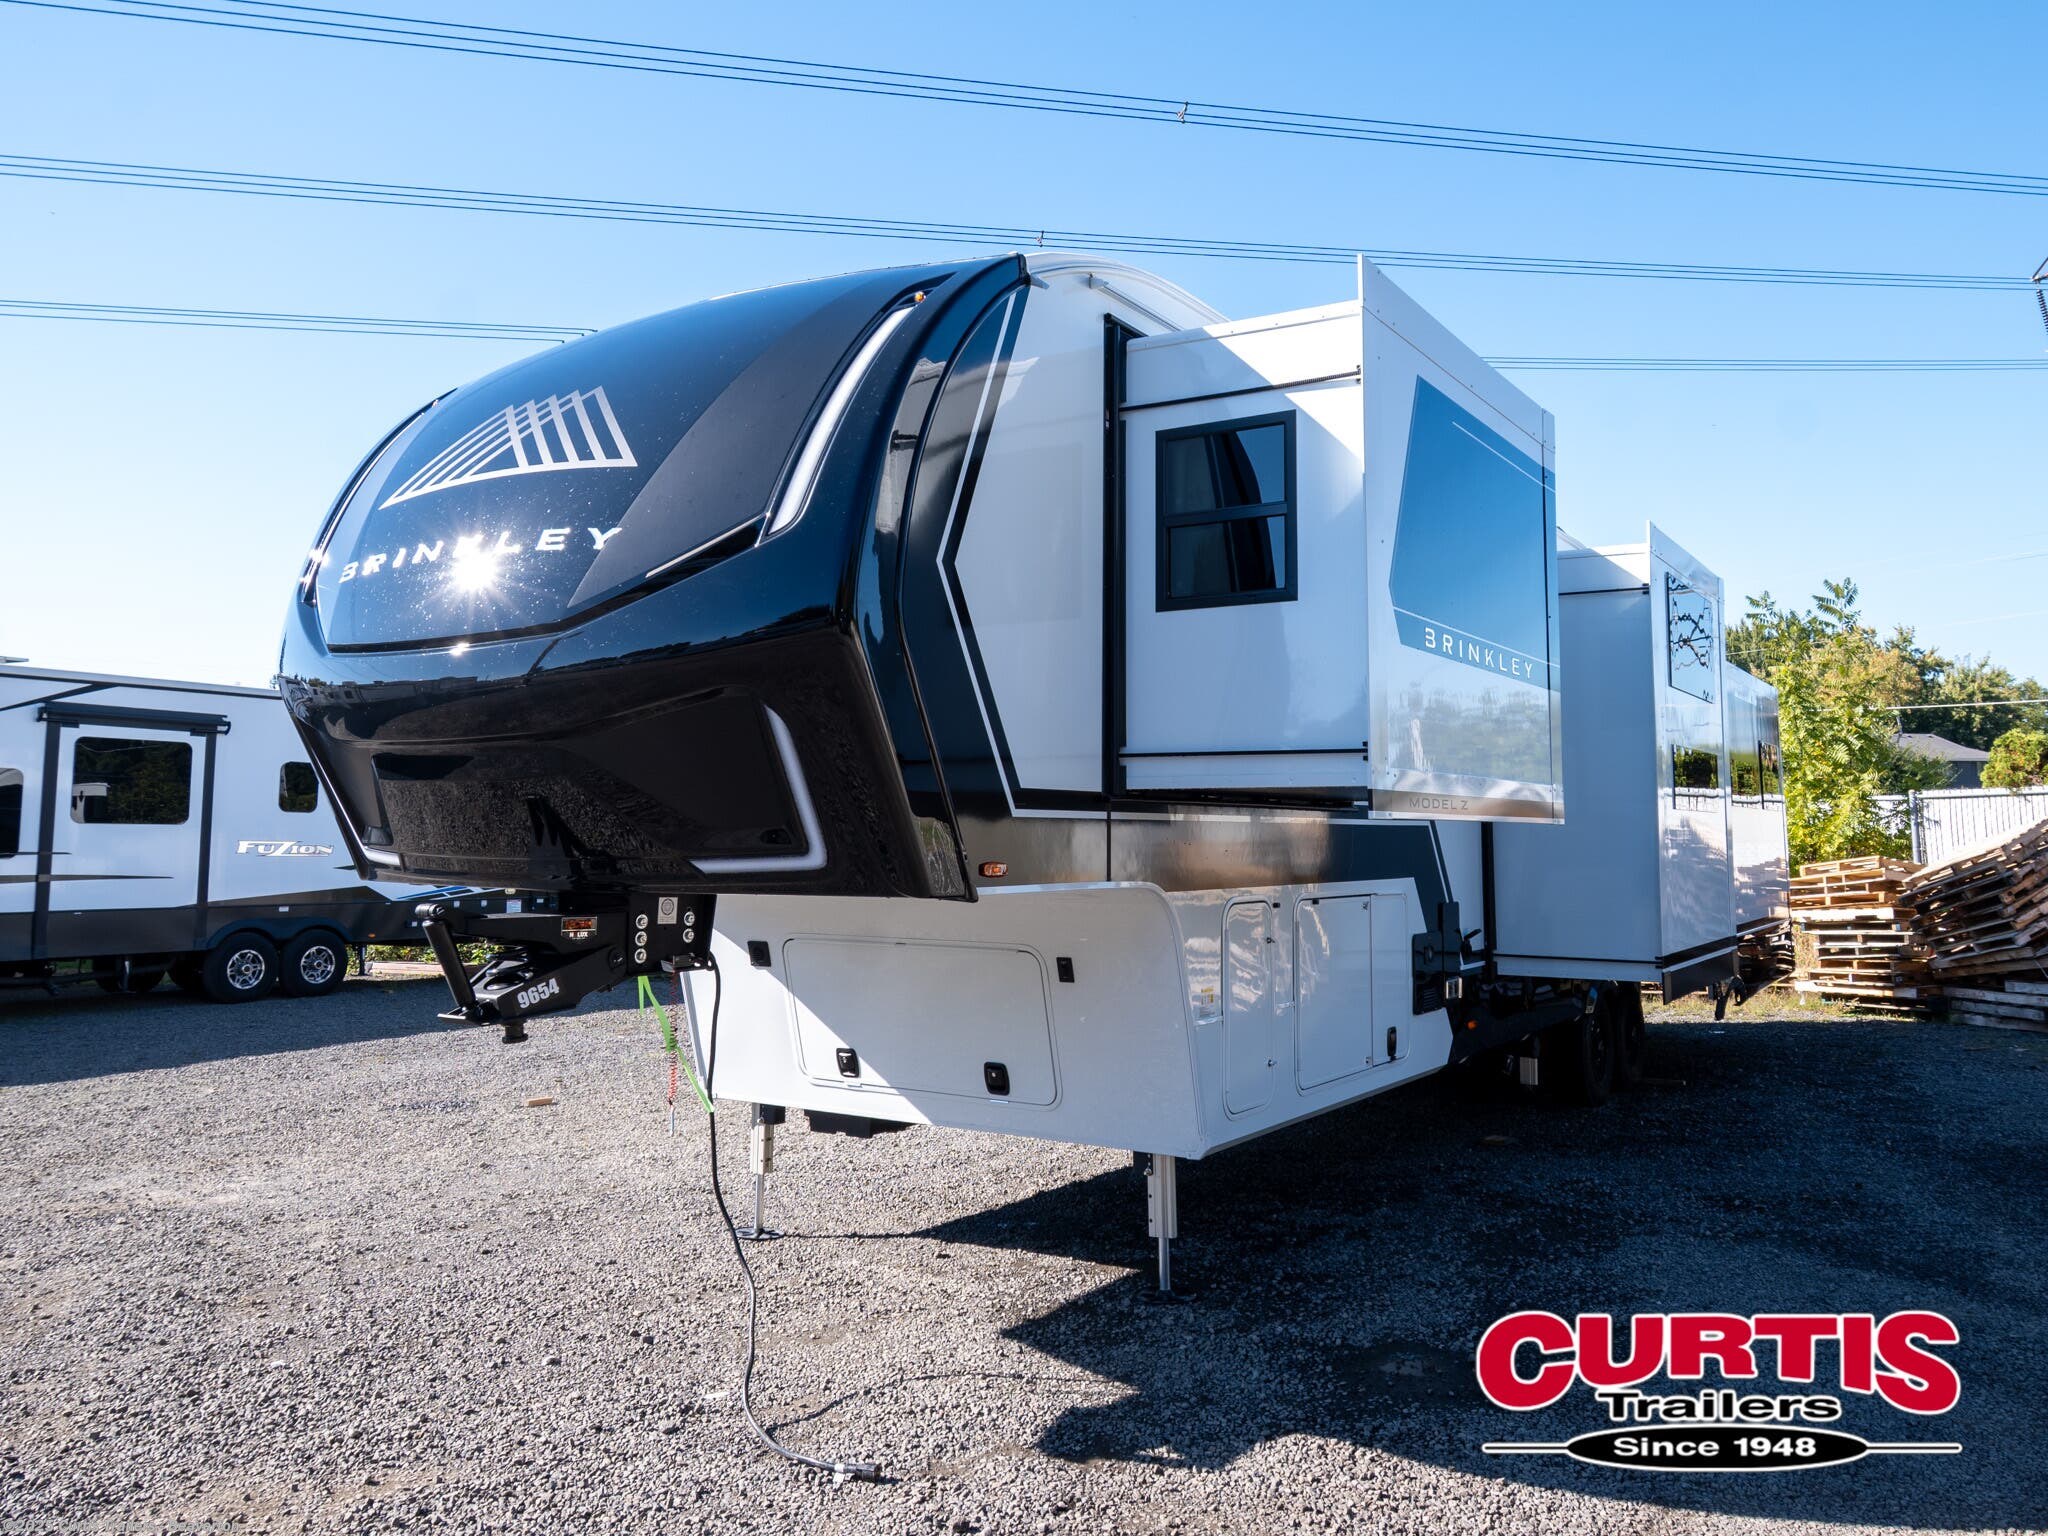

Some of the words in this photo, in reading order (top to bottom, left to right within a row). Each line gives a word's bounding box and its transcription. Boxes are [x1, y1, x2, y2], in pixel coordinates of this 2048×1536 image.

[1425, 627, 1533, 678] BRINKLEY
[1408, 797, 1457, 810] MODEL
[1460, 799, 1469, 810] Z
[517, 978, 559, 1008] 9654
